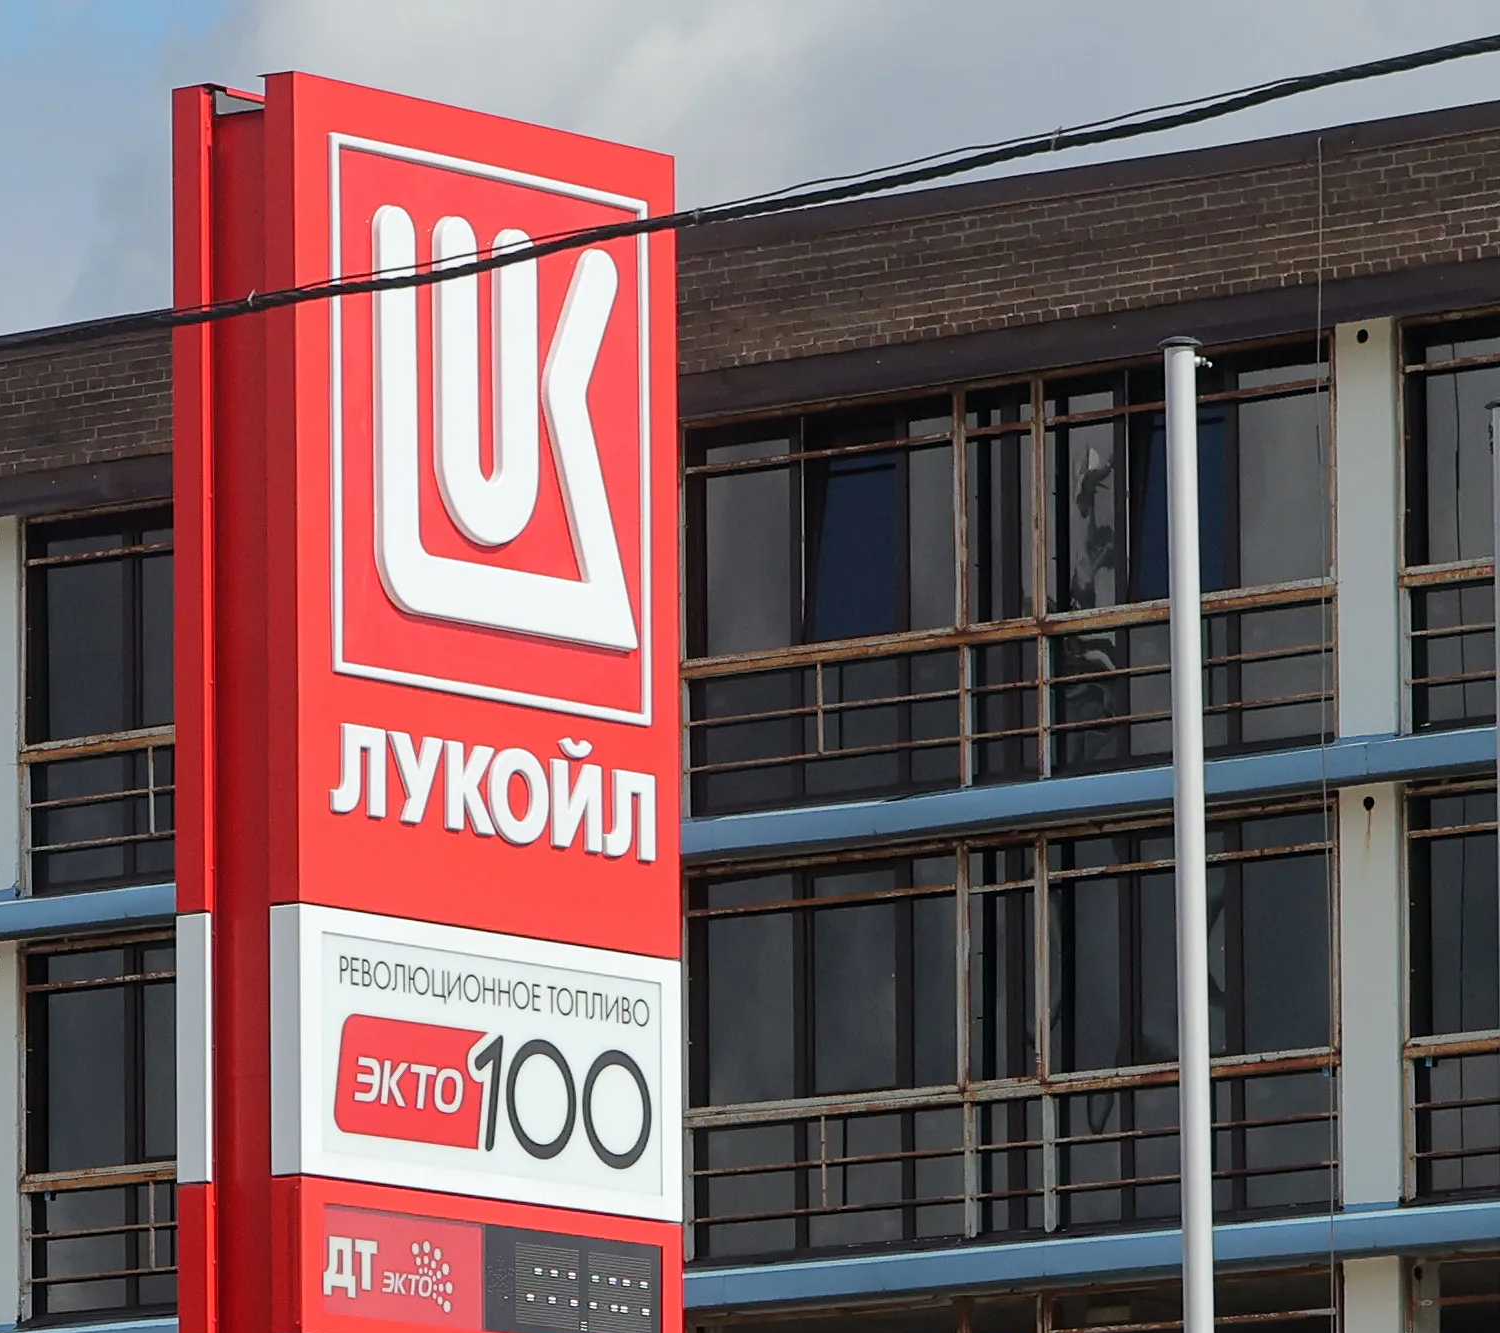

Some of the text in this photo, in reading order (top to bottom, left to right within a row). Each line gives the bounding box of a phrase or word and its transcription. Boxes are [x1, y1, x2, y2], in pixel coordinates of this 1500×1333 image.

[330, 722, 658, 864] ЛУКОЙЛ
[338, 955, 650, 1028] РЕВОЛЮЦИОННОЕ ТОПЛИВО
[352, 1034, 652, 1170] ЭКТО 100
[323, 1235, 434, 1299] ДТ ЭКТО
